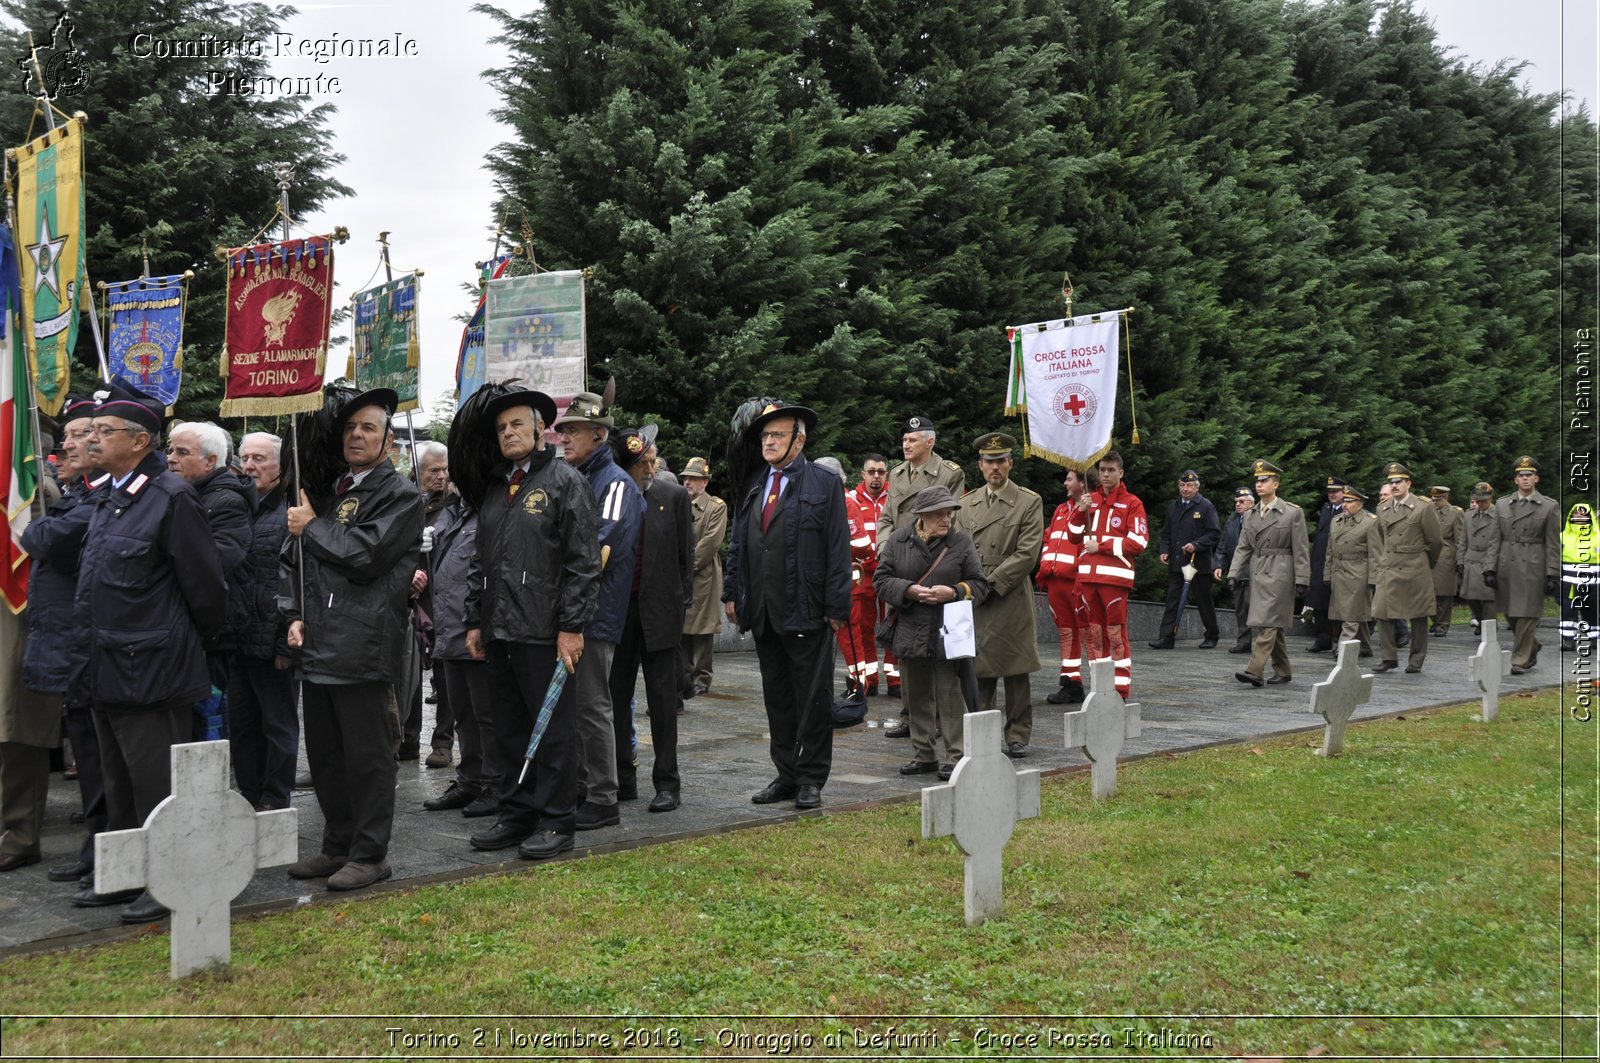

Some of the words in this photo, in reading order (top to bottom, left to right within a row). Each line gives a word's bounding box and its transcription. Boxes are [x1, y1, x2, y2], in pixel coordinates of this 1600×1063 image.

[1034, 350, 1067, 362] CROCE
[1071, 345, 1106, 357] ROSSA
[1048, 358, 1093, 373] ITALIANA
[249, 369, 299, 386] TORINO
[1043, 372, 1071, 381] COMITATO
[1079, 368, 1100, 376] TORINO
